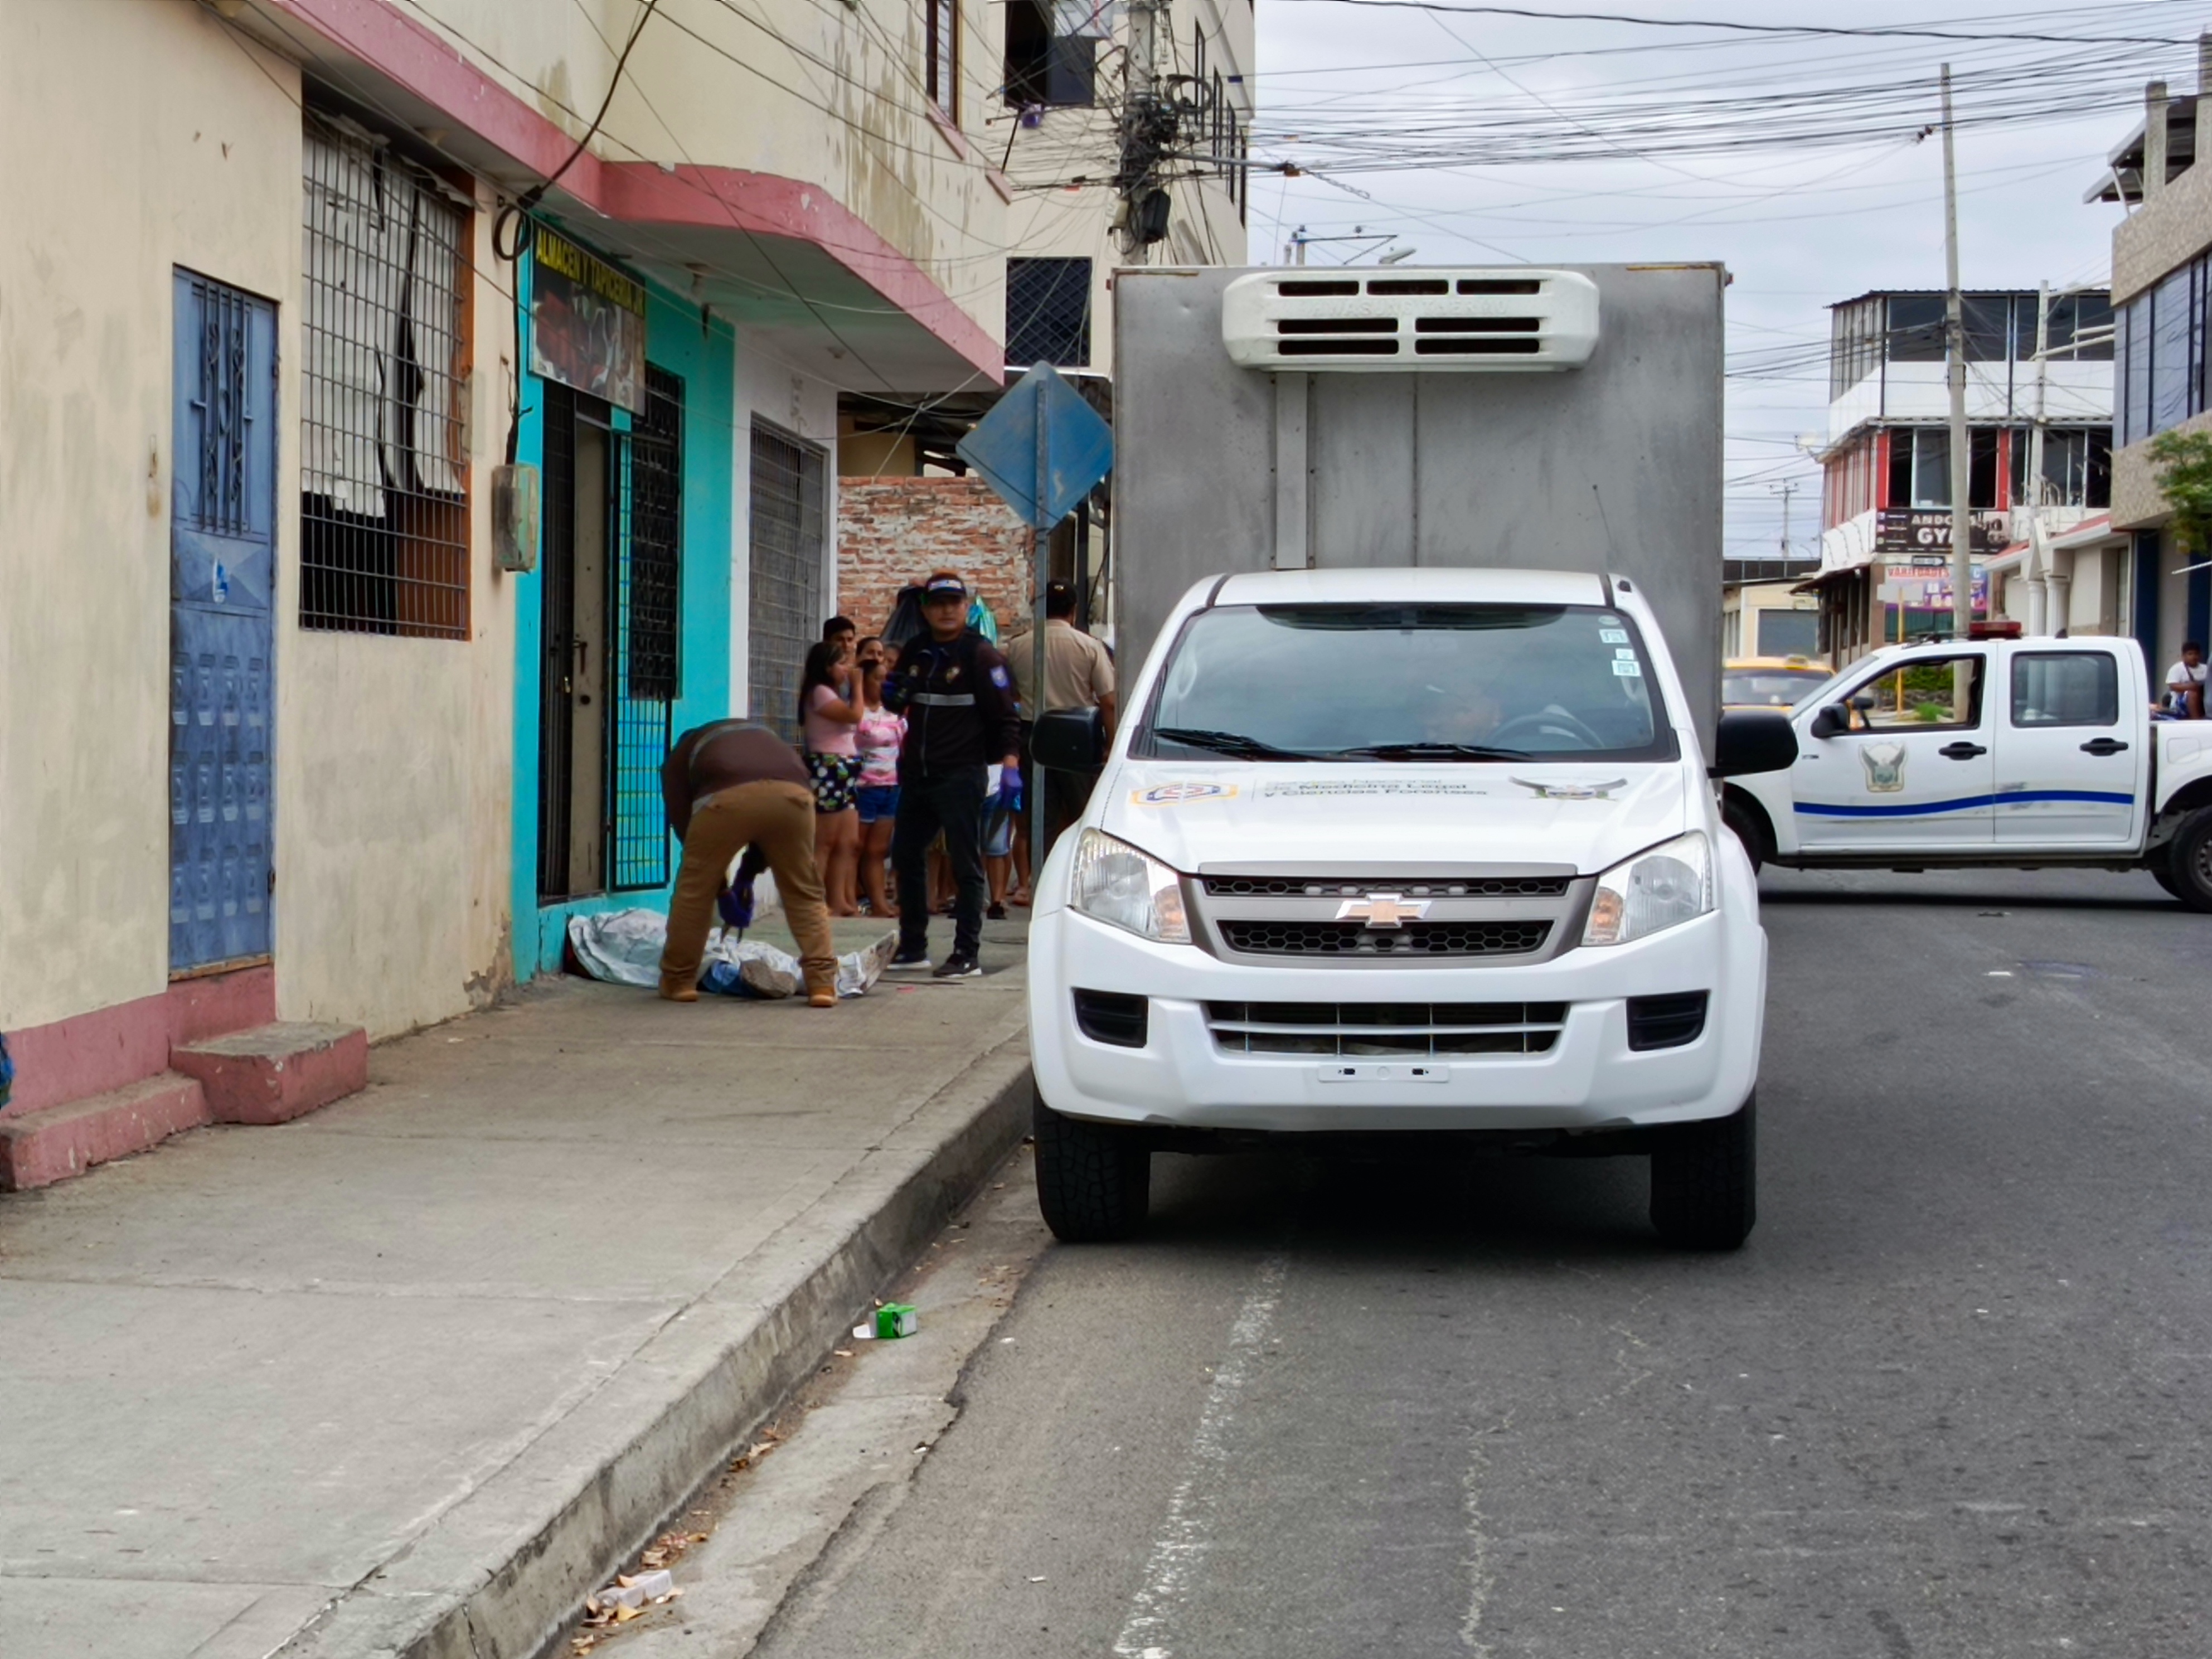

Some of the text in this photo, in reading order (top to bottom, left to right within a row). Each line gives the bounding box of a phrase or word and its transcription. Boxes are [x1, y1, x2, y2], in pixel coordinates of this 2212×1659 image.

[536, 227, 580, 281] ALMACEN
[583, 253, 589, 285] Y
[590, 256, 632, 311] TAPICERIA
